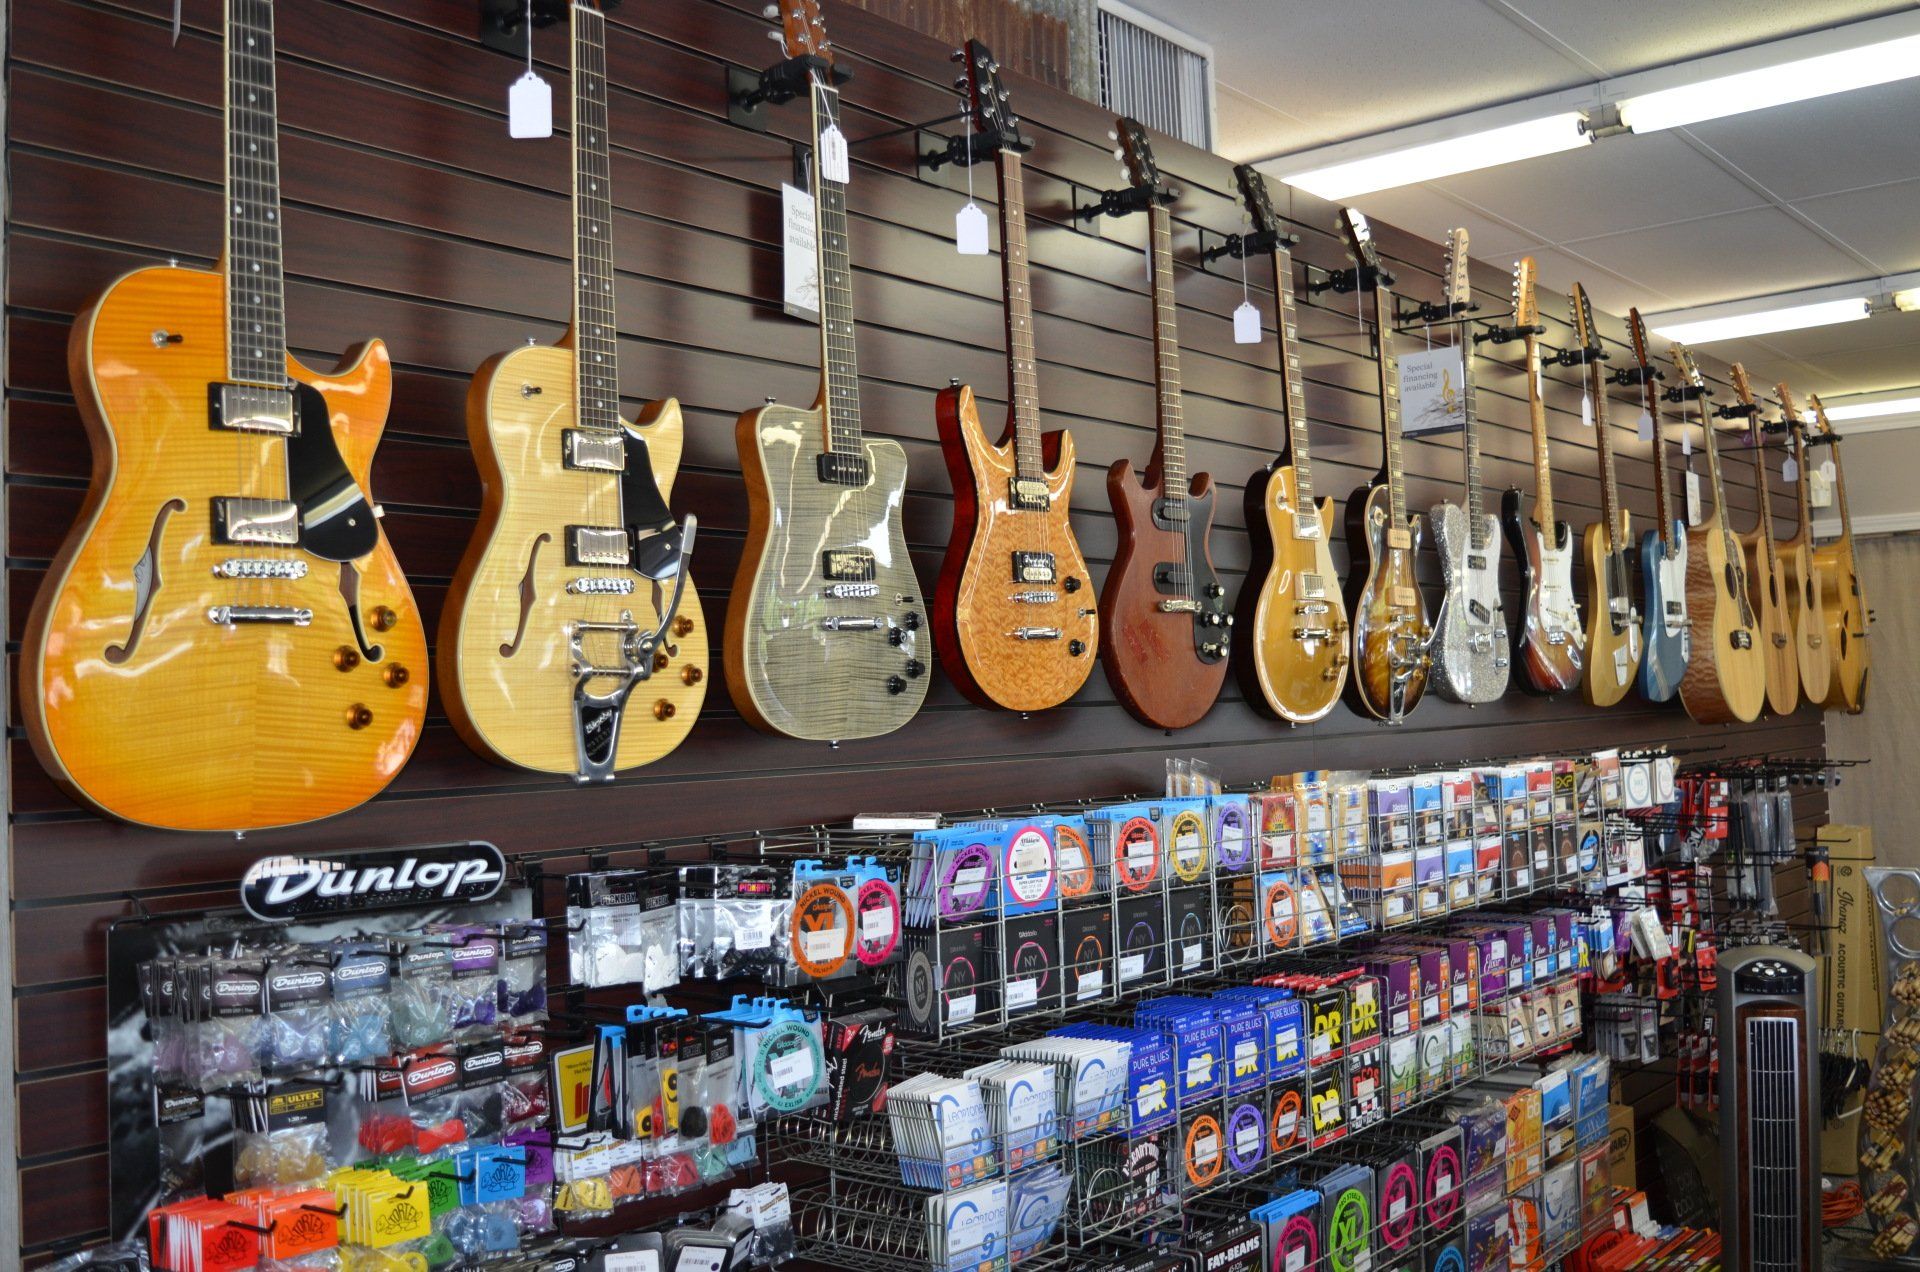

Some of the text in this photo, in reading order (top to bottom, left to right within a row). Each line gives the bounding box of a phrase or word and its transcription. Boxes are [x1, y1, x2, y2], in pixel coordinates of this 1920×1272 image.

[791, 205, 814, 223] Special
[788, 217, 817, 240] financin
[1406, 361, 1433, 373] Special
[1403, 371, 1438, 383] financing
[262, 857, 501, 905] Dunlop
[601, 892, 637, 906] PICKBOY
[800, 889, 821, 909] NICKEL
[823, 887, 846, 903] WOUND
[1837, 887, 1854, 935] Ibanez
[1135, 934, 1146, 946] NY
[408, 951, 446, 962] Dunlop
[454, 948, 493, 960] Dunlop
[1024, 955, 1037, 967] NY
[1083, 949, 1094, 960] NY
[341, 964, 384, 977] Dunlop
[1838, 943, 1846, 989] ACOUSTIC
[275, 974, 323, 988] Dunlop
[915, 976, 926, 994] NY
[954, 971, 966, 984] NY
[219, 983, 257, 993] Dunlop
[1270, 1003, 1299, 1020] PURE BLUES
[1352, 999, 1377, 1035] DR
[860, 1021, 886, 1044] Fender
[1230, 1017, 1262, 1034] PURE BLUES
[1314, 1011, 1341, 1044] DR
[764, 1024, 810, 1048] NICKEL WOUND
[1184, 1026, 1219, 1044] PURE BLUES
[504, 1044, 541, 1056] Dunlop
[466, 1053, 501, 1067] Dunlop
[1133, 1051, 1170, 1071] PURE BLUES
[411, 1064, 453, 1082] Dunlop
[855, 1062, 881, 1082] Fender
[288, 1091, 320, 1103] ULTEX
[1311, 1088, 1342, 1130] DR
[389, 1202, 417, 1223] TORTEX
[292, 1213, 324, 1236] TORTEX
[1199, 1230, 1214, 1242] ELECTRIC
[1338, 1216, 1362, 1252] XL
[1207, 1236, 1260, 1271] FAT-BEAMS
